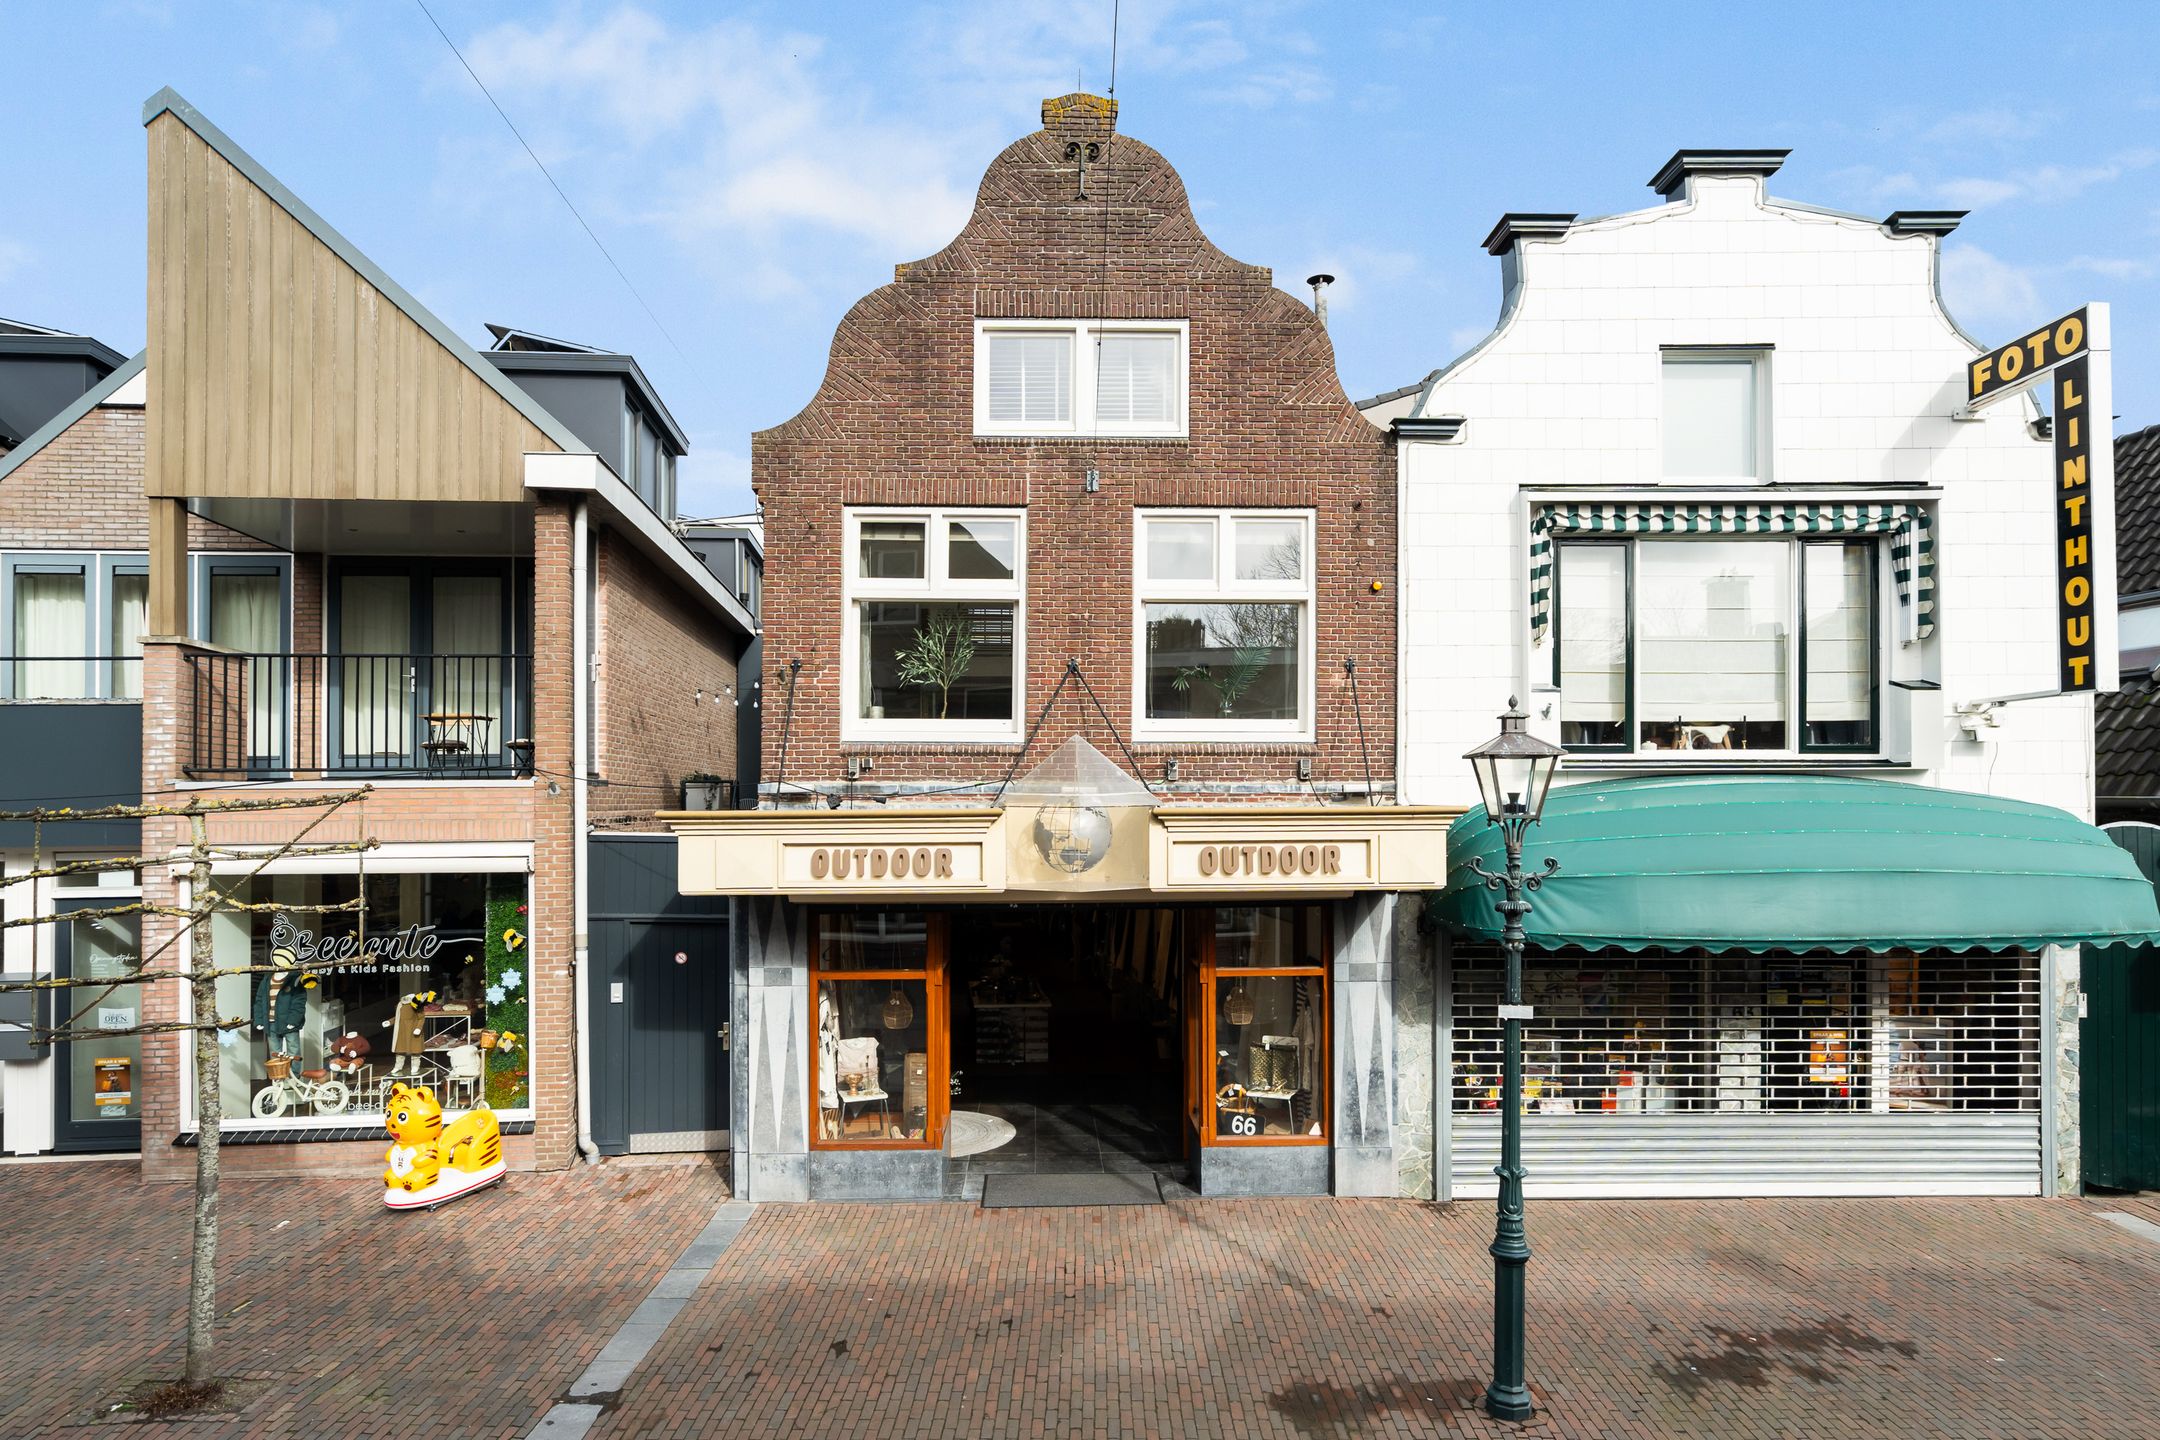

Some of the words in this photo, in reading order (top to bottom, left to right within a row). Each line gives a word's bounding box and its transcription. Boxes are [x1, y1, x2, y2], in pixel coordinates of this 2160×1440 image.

[1973, 317, 2083, 396] FOTO
[2062, 379, 2090, 686] LINTHOUT
[810, 848, 953, 878] OUTDOOR
[1200, 845, 1341, 875] OUTDOOR
[350, 964, 378, 974] Kids
[382, 963, 431, 974] Fashion
[1231, 1115, 1257, 1136] 66
